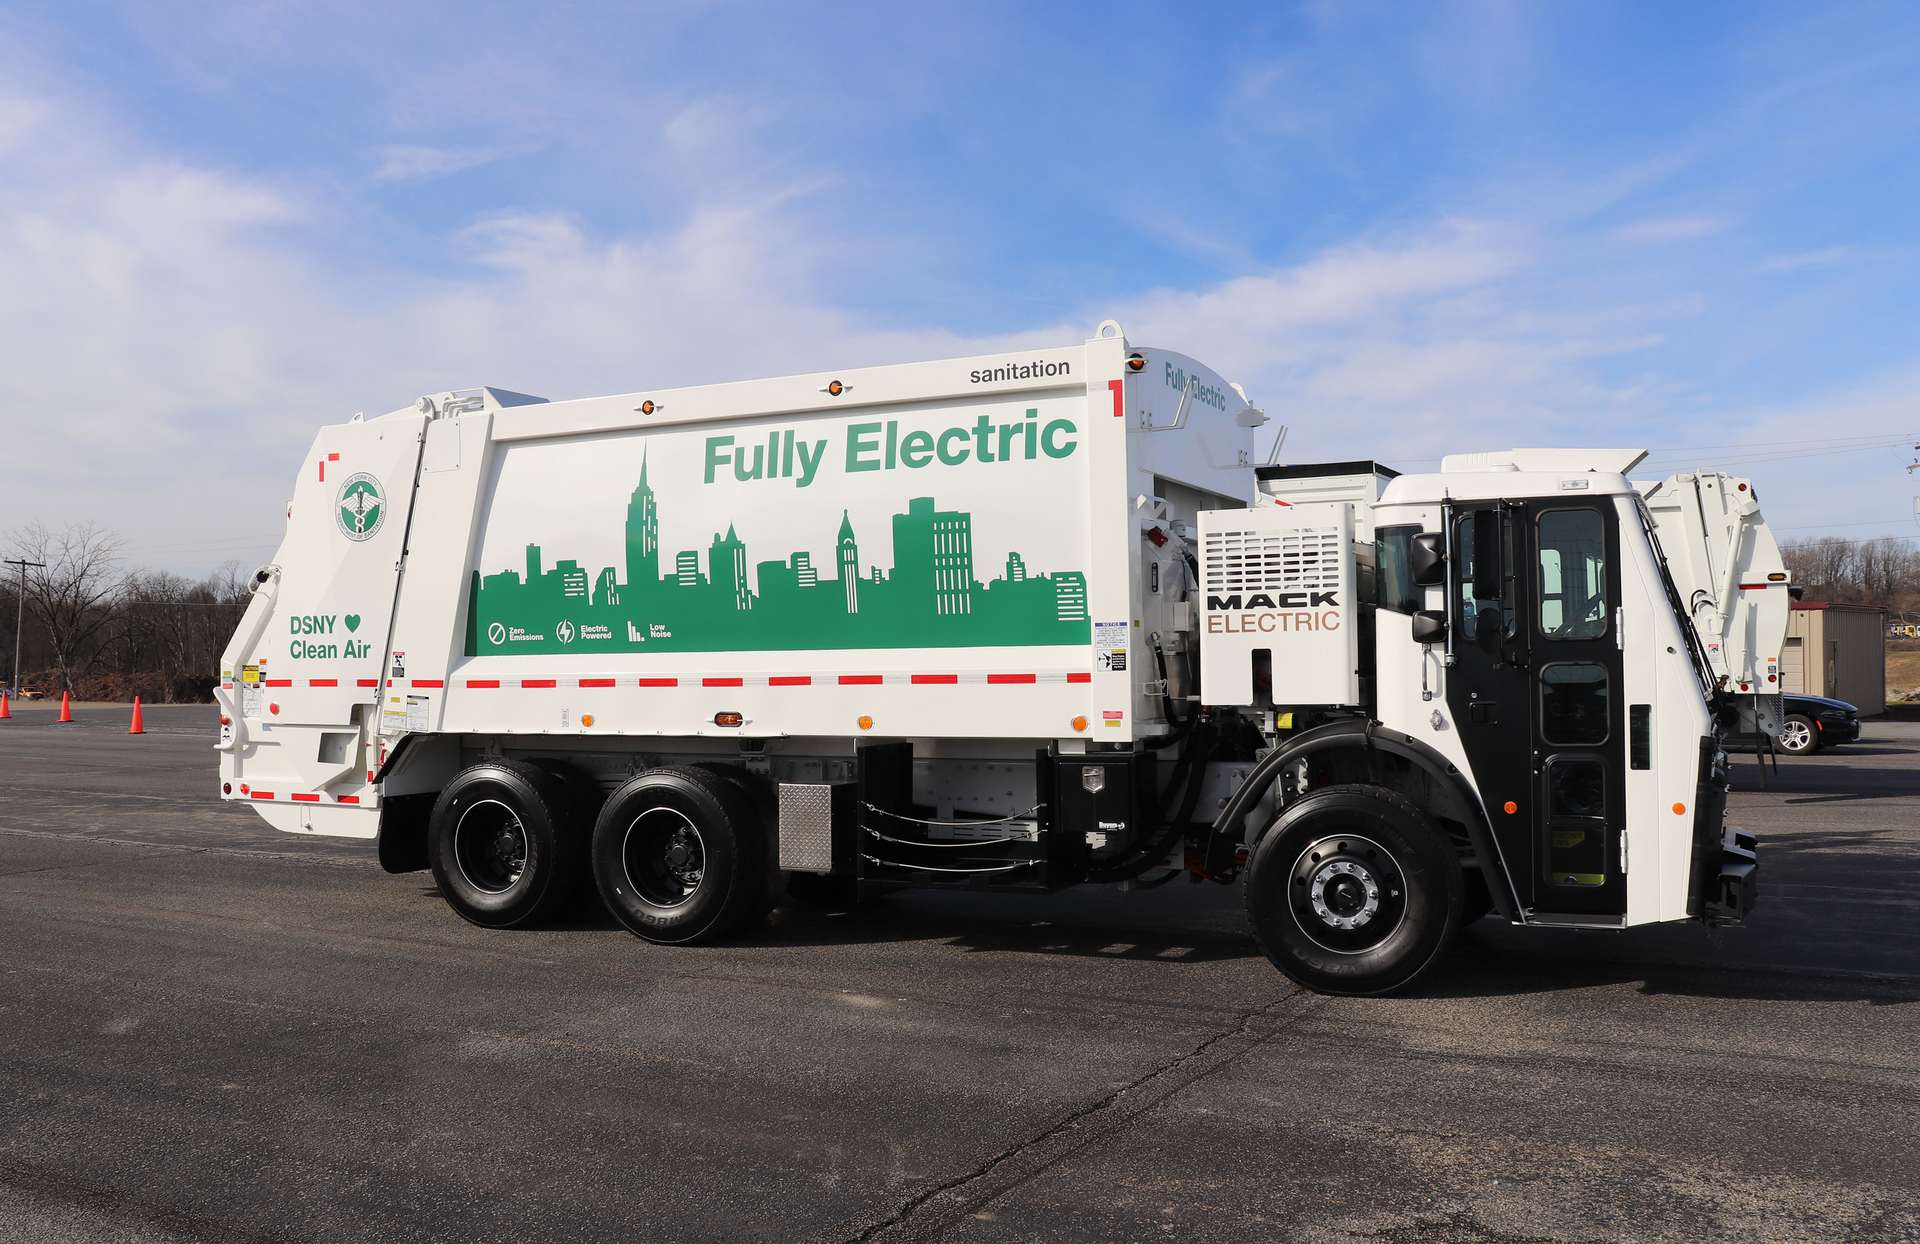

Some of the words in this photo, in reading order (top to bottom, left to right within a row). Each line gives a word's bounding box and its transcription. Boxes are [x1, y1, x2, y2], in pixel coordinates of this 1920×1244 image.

[971, 360, 1071, 384] sanitation
[704, 429, 828, 488] Fully
[846, 408, 1078, 473] Electric
[1207, 591, 1340, 610] MACK
[290, 615, 337, 635] DSNY
[580, 624, 608, 632] Electric
[650, 623, 665, 631] Low
[1207, 611, 1341, 633] ELECTRIC
[509, 633, 544, 641] Emissions
[581, 631, 612, 639] Powered
[650, 630, 672, 638] Noise
[290, 640, 338, 660] Clean
[343, 640, 372, 659] Air
